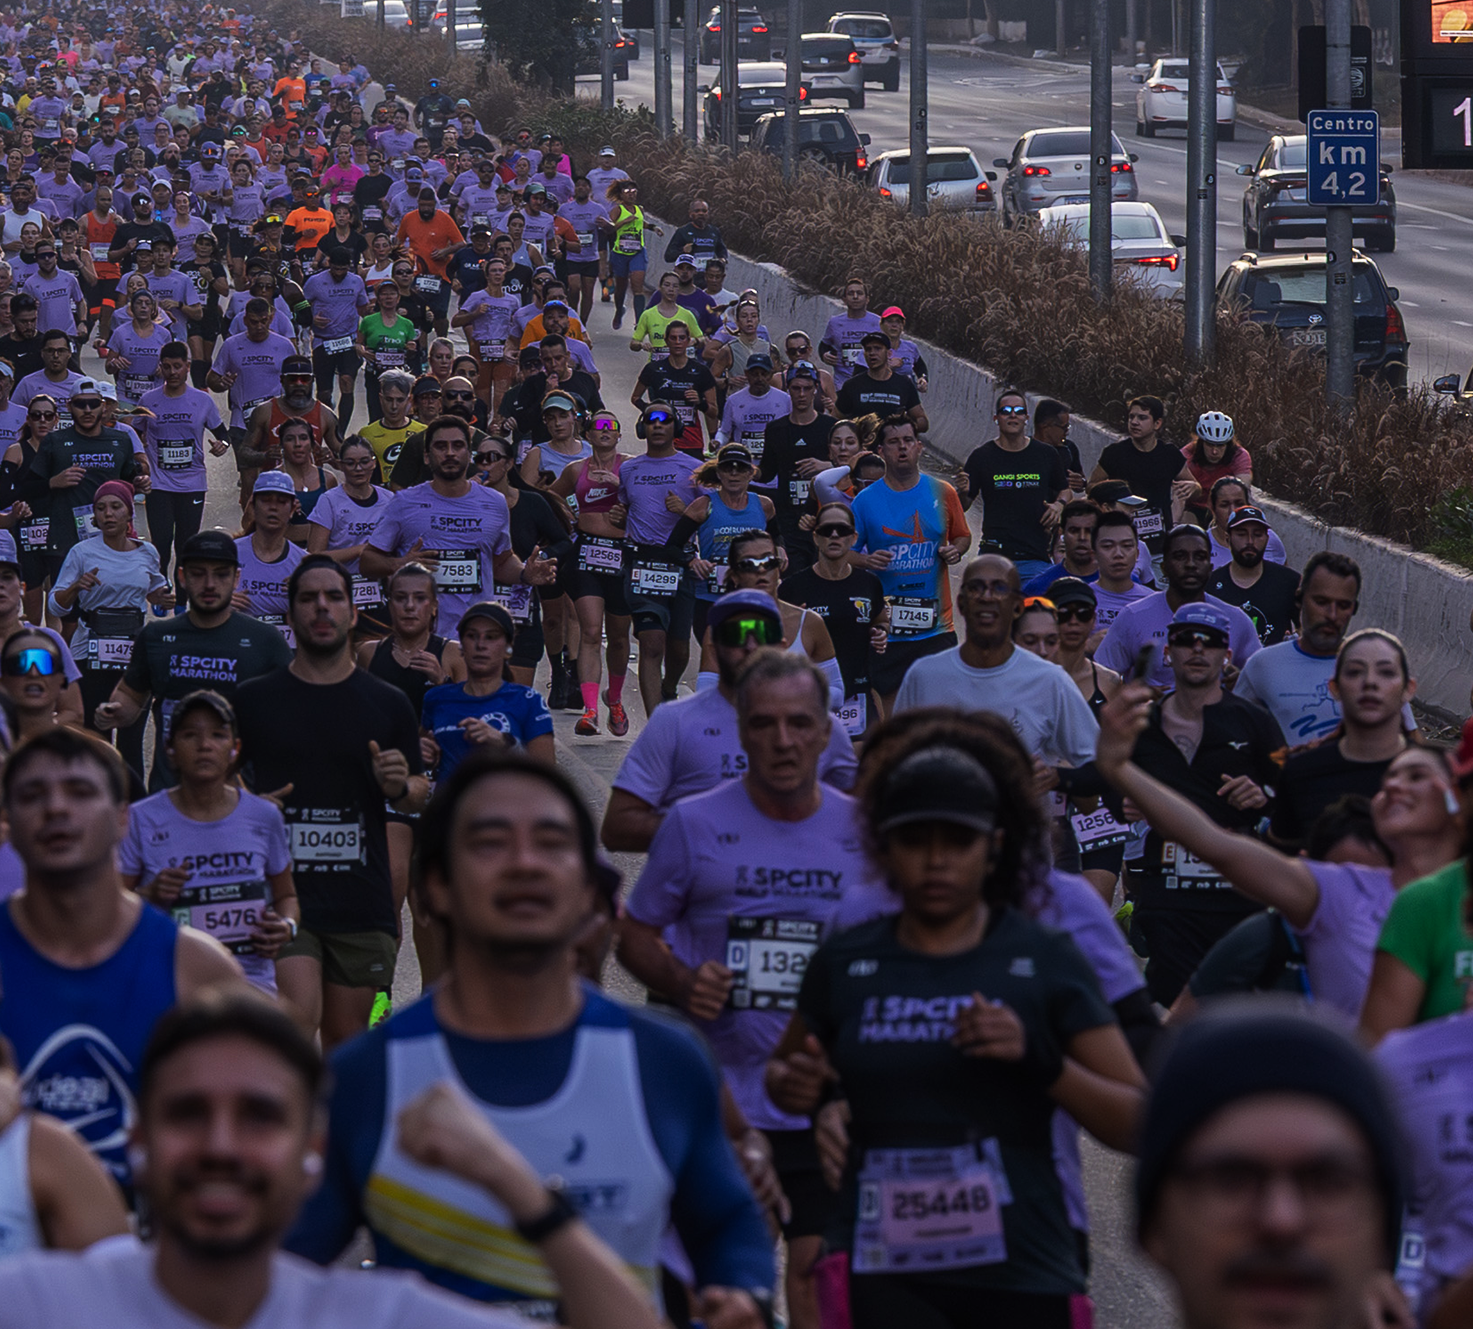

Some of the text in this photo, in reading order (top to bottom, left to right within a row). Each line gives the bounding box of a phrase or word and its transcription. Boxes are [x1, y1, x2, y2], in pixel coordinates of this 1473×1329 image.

[1313, 117, 1374, 130] Centro
[1319, 141, 1366, 165] km
[1321, 172, 1365, 198] 4,2
[248, 355, 273, 363] SPCITY
[168, 450, 190, 458] 11183
[588, 488, 608, 497] NIKE
[439, 517, 482, 527] SPCITY
[31, 529, 47, 538] 102
[590, 550, 620, 562] 12565
[442, 565, 473, 576] 7583
[633, 571, 639, 579] E
[644, 573, 676, 584] 14299
[353, 588, 377, 597] 7281
[898, 610, 929, 621] 17145
[90, 641, 97, 651] D
[180, 656, 237, 670] SPCITY
[170, 668, 237, 682] MARATHON
[312, 809, 340, 817] SPCITY
[299, 831, 357, 847] 10403
[1166, 845, 1173, 859] E
[184, 853, 253, 869] SPCITY
[756, 868, 842, 888] SPCITY
[205, 909, 256, 930] 5476
[893, 1185, 990, 1220] 25448
